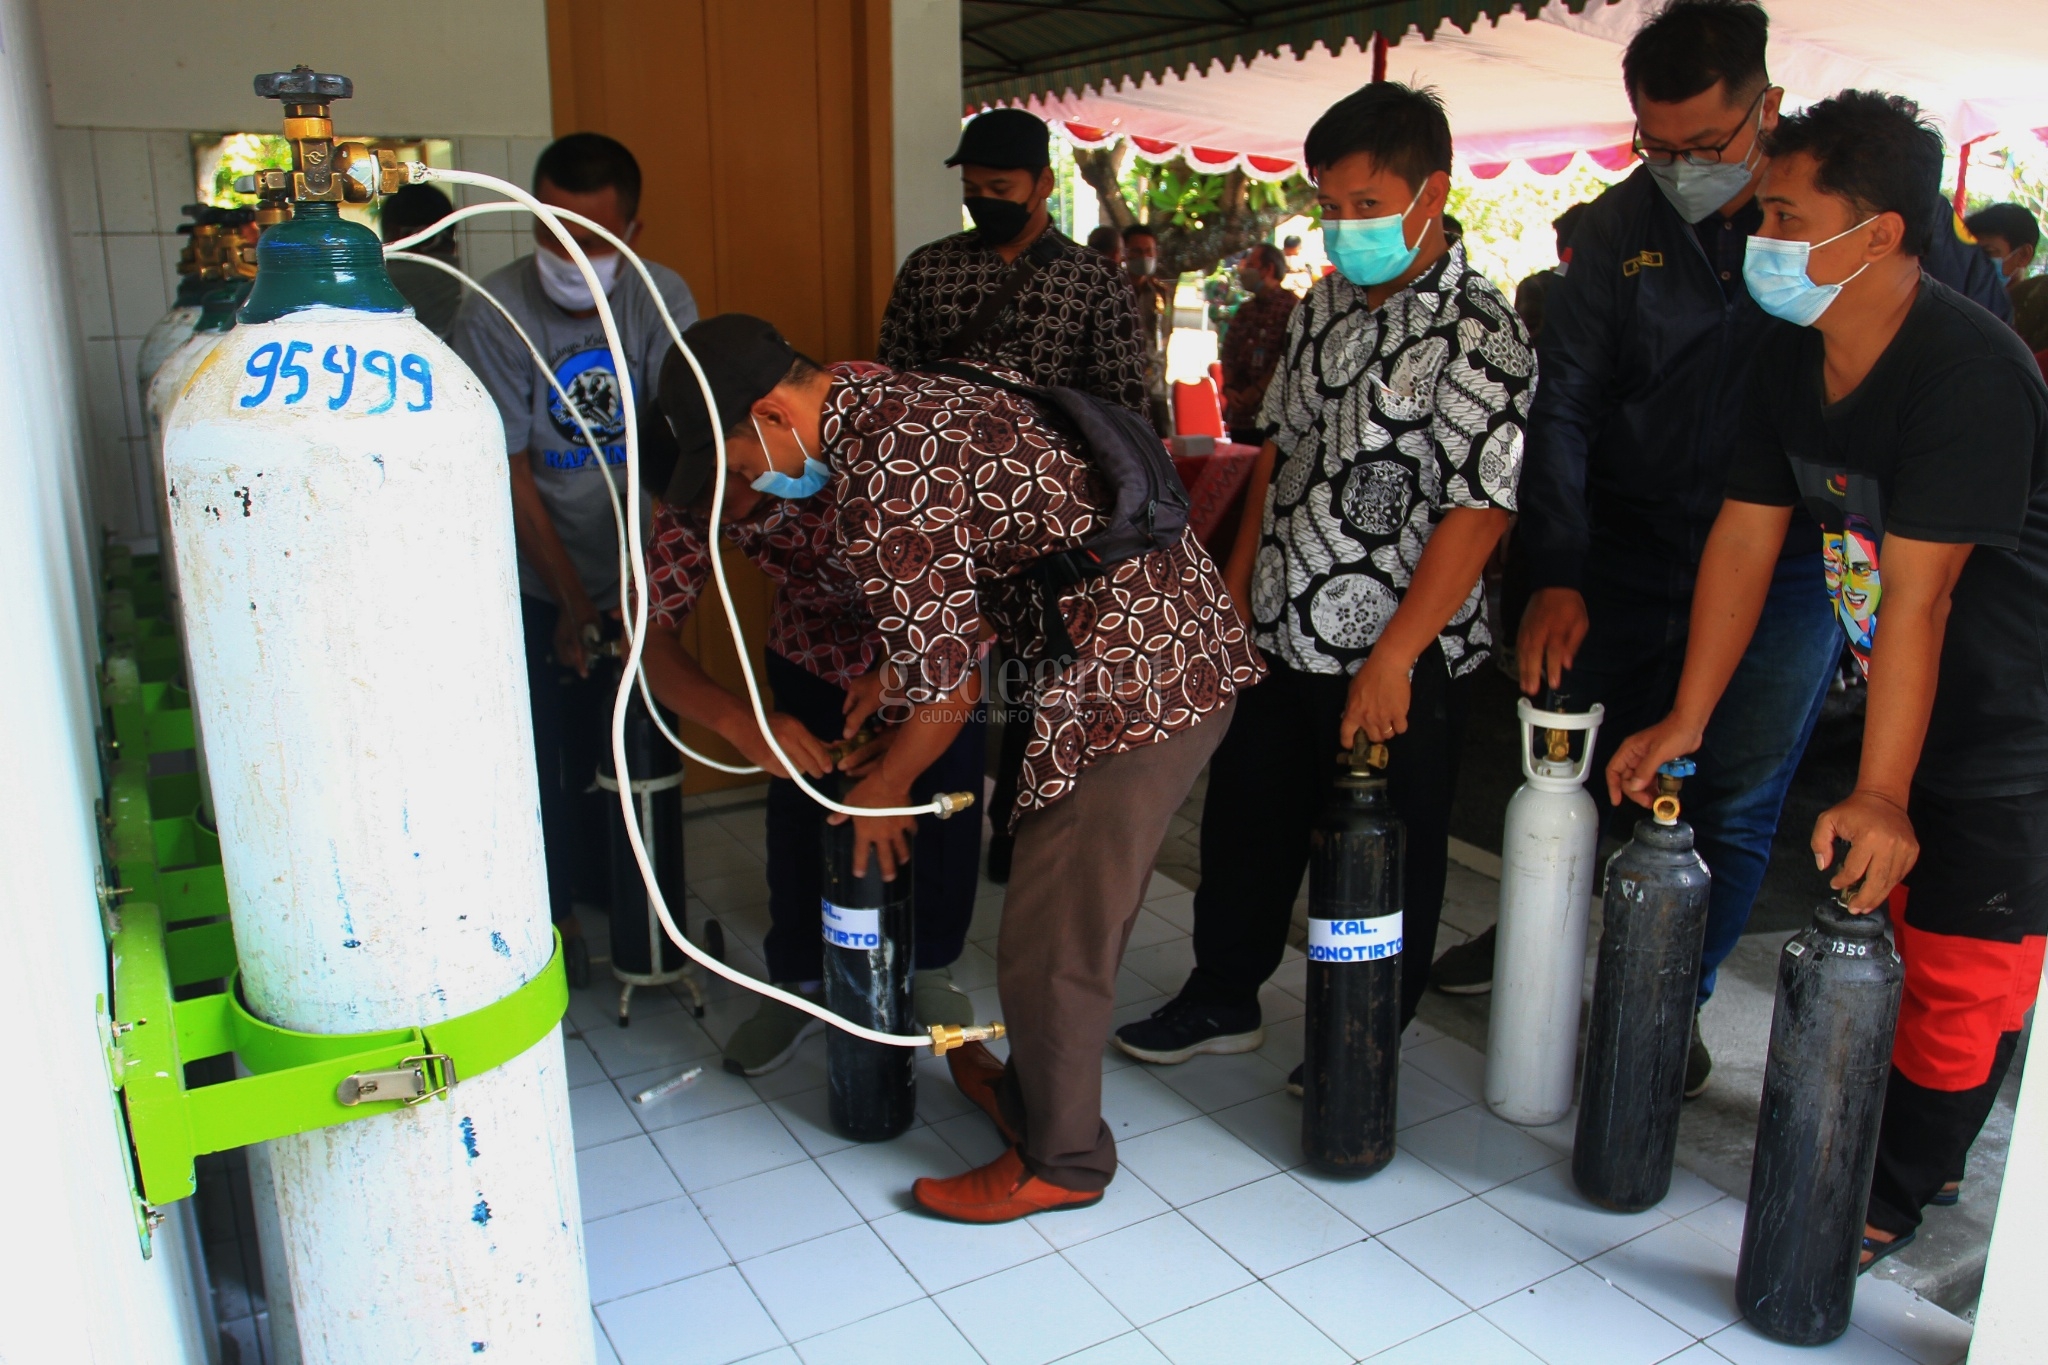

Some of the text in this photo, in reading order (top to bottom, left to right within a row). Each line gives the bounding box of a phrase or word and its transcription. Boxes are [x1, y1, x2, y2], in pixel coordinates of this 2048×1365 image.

[544, 446, 628, 469] RAFIN
[822, 901, 842, 921] AL.
[822, 921, 879, 947] TIRTO
[1330, 921, 1378, 936] KAL.
[1831, 941, 1866, 956] 1350
